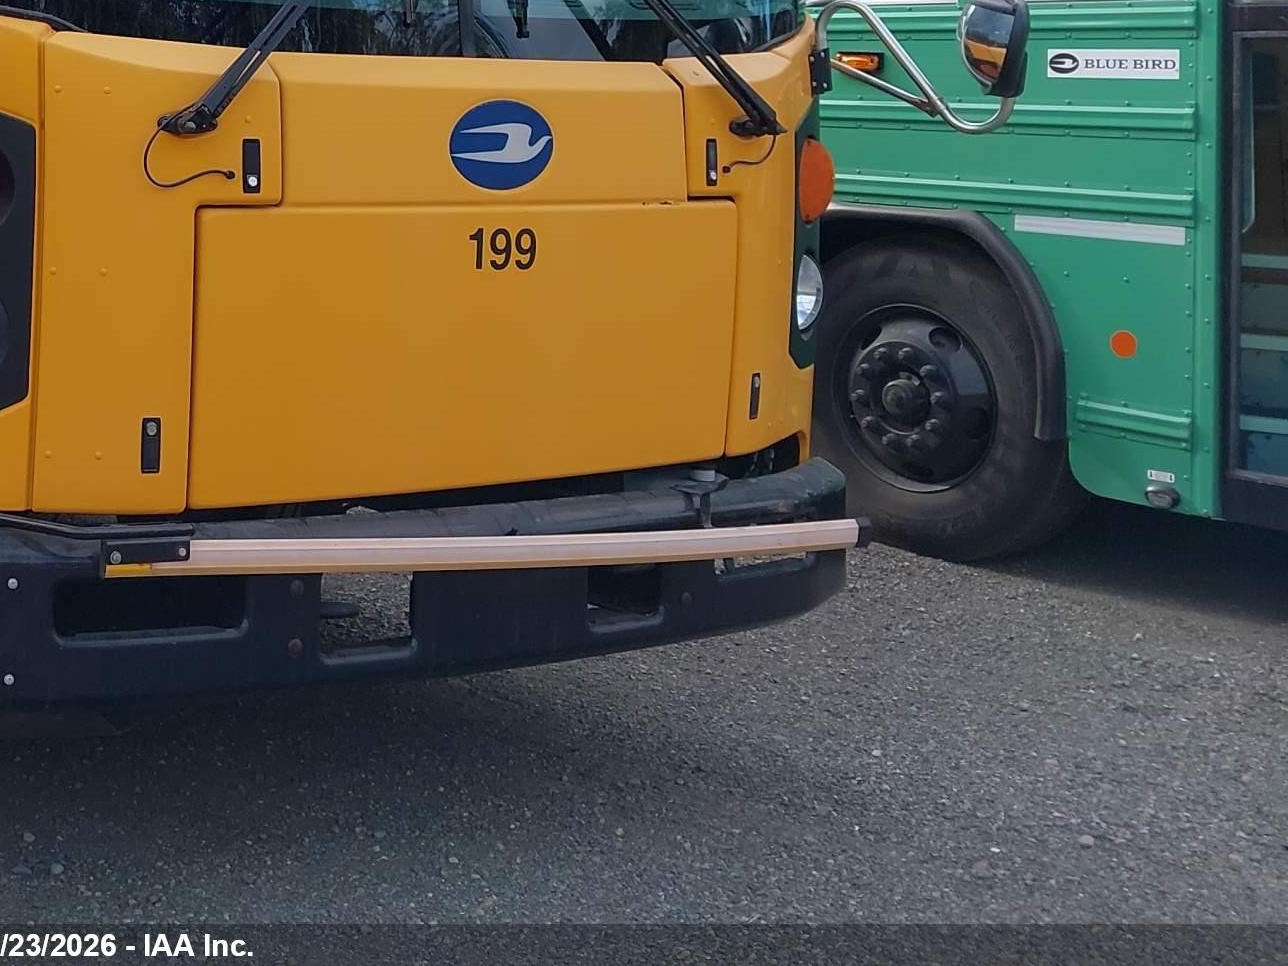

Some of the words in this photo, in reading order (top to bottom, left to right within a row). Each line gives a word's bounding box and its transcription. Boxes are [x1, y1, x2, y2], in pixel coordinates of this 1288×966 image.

[1084, 58, 1129, 70] BLUE
[1133, 58, 1177, 70] BIRD
[469, 227, 537, 271] 199
